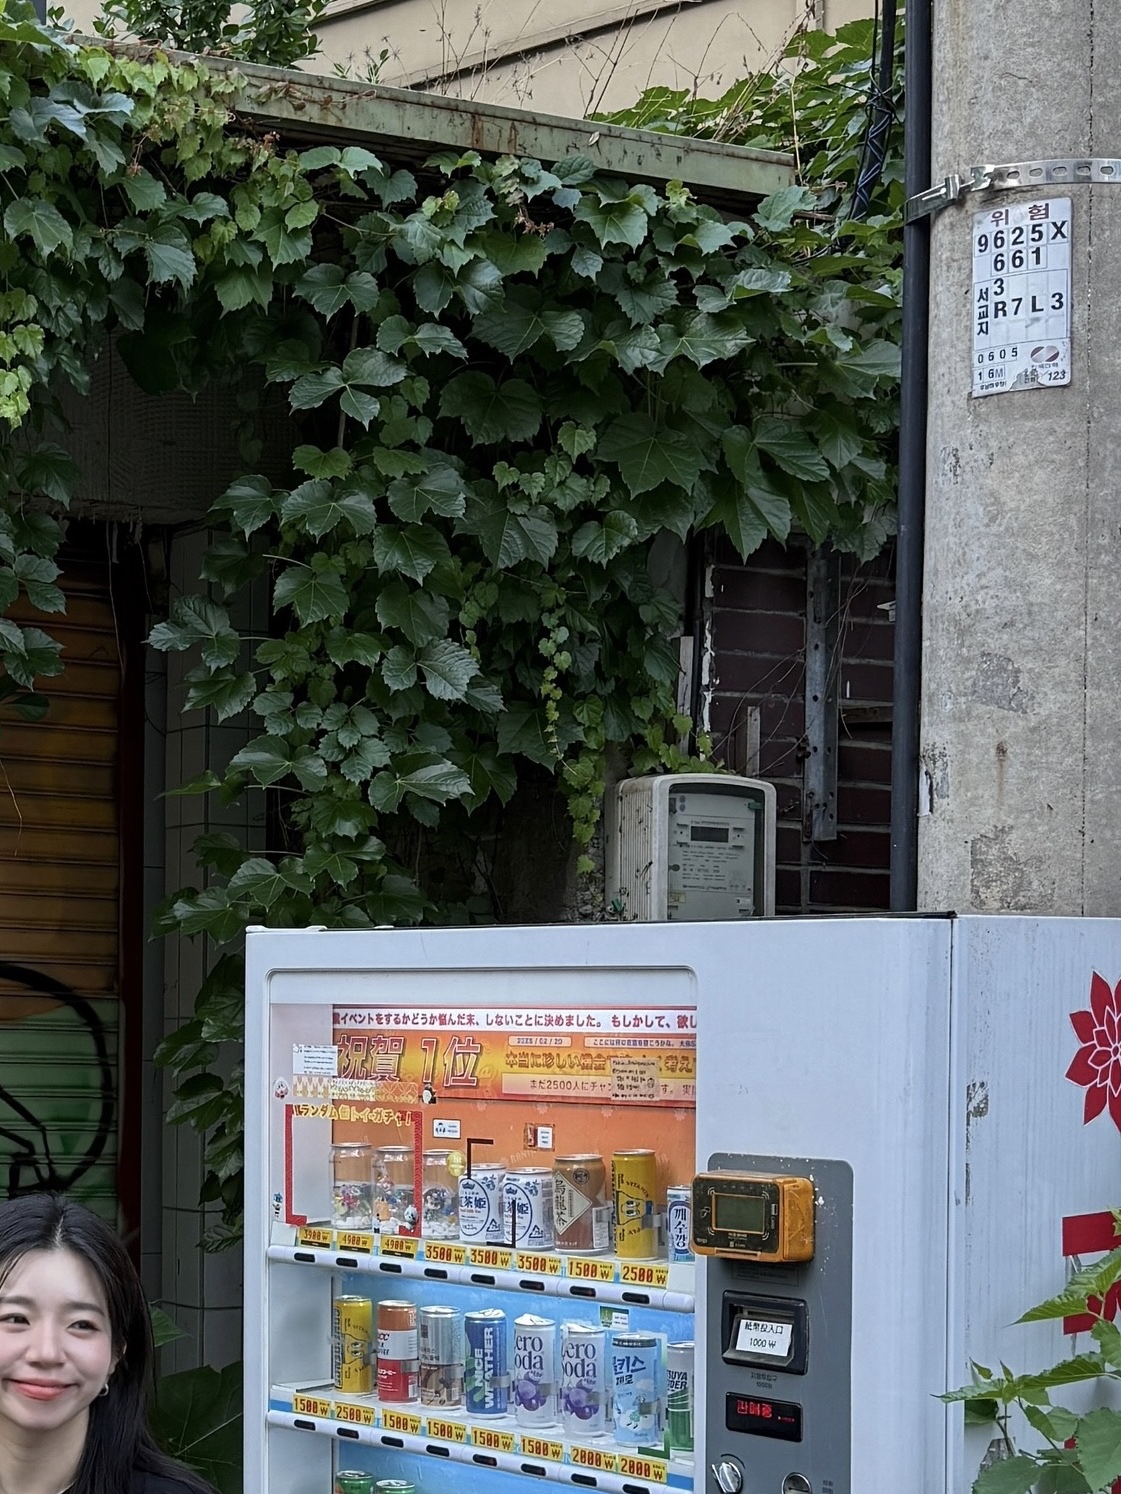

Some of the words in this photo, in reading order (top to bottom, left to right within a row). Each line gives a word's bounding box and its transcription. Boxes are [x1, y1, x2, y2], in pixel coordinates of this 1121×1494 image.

[991, 203, 1049, 227] 위험
[978, 221, 1067, 253] 9625X
[994, 247, 1040, 272] 661
[993, 278, 1004, 296] 3
[977, 287, 989, 336] 서교지
[994, 292, 1064, 318] R7L3
[978, 347, 1018, 364] 0605
[1048, 369, 1067, 381] 123
[337, 1033, 405, 1082] 祝賀
[421, 1036, 481, 1087] 1位
[426, 1245, 452, 1261] 3500
[470, 1250, 497, 1265] 3500
[518, 1255, 547, 1271] 3500
[569, 1261, 597, 1278] 1500
[622, 1266, 653, 1282] 2500
[515, 1335, 543, 1352] ero
[475, 1348, 483, 1387] NICE
[514, 1351, 544, 1371] oda
[294, 1400, 318, 1413] 1500
[337, 1405, 362, 1422] 2500
[383, 1413, 408, 1430] 1500
[428, 1420, 453, 1438] 1500
[473, 1430, 499, 1448] 1500
[522, 1439, 548, 1456] 1500
[572, 1448, 601, 1466] 2000
[620, 1459, 650, 1477] 2000
